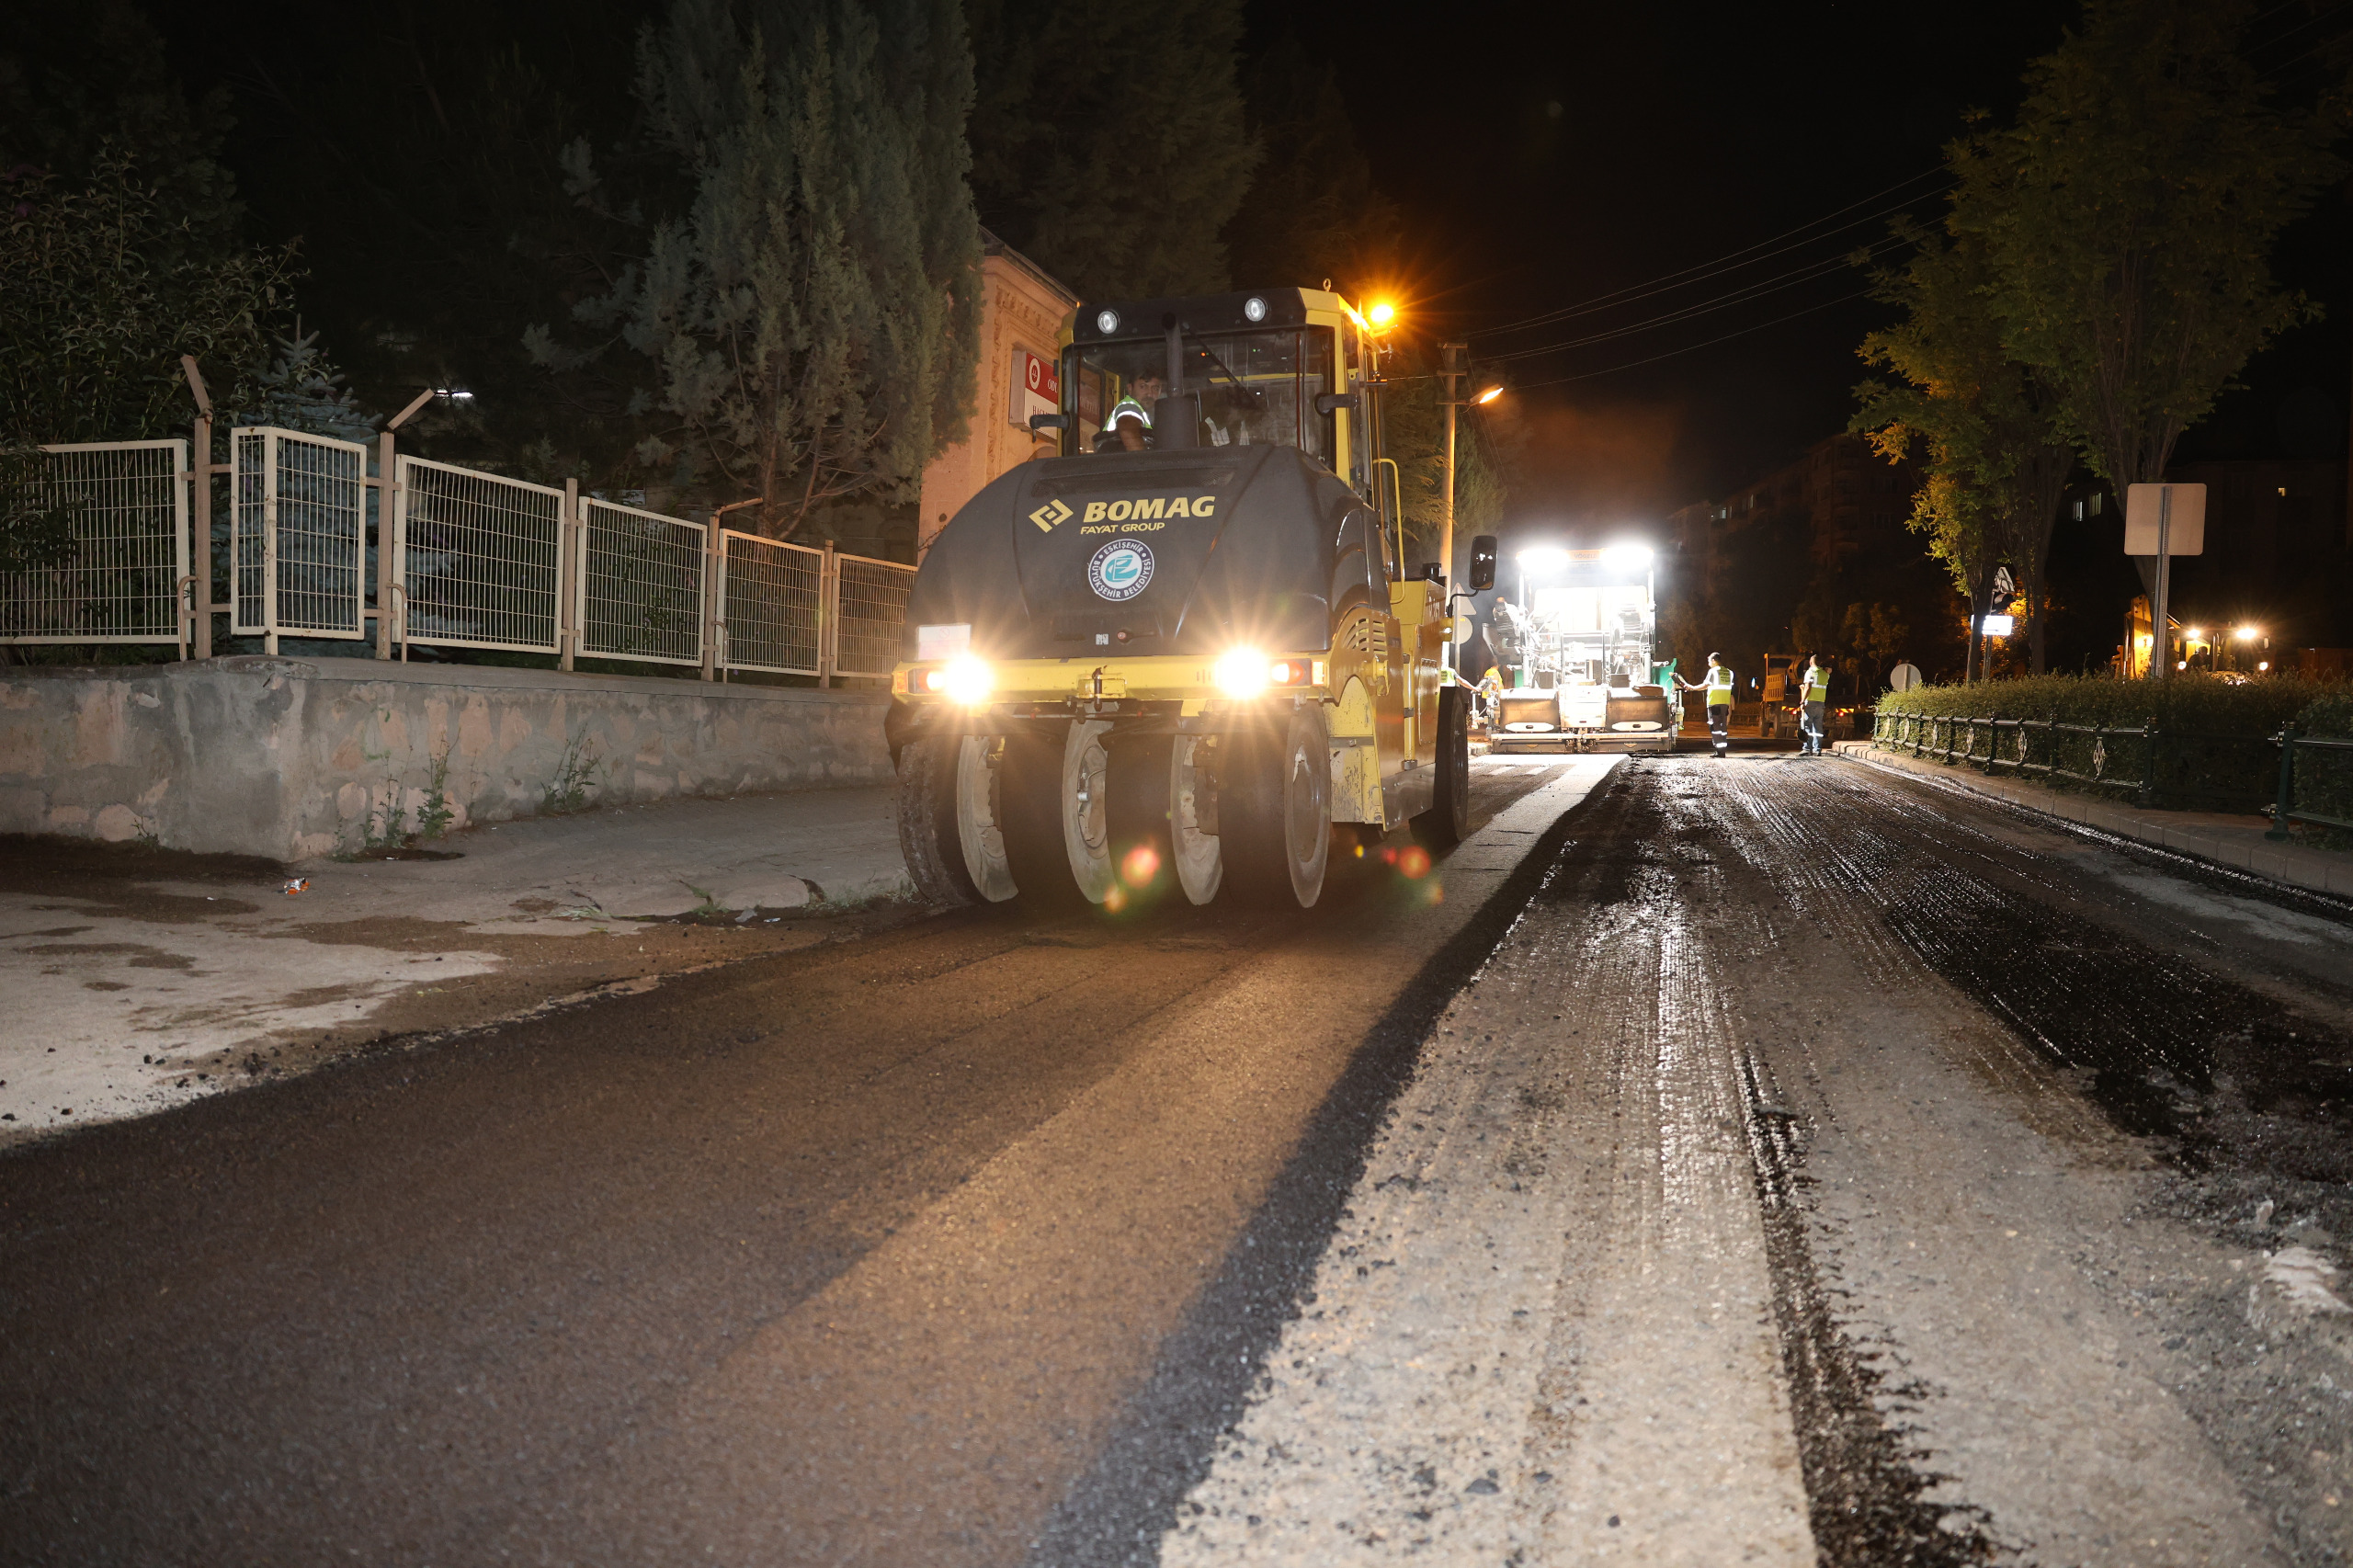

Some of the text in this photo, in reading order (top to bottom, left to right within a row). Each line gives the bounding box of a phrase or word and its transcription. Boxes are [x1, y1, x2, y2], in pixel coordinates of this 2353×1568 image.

[1083, 495, 1216, 523] BOMAG
[1080, 522, 1165, 535] FAYAT GROUP
[1103, 540, 1143, 555] ESKİŞEHİR
[1091, 558, 1152, 598] BÜYÜKŞEHİR BELEDİYESİ
